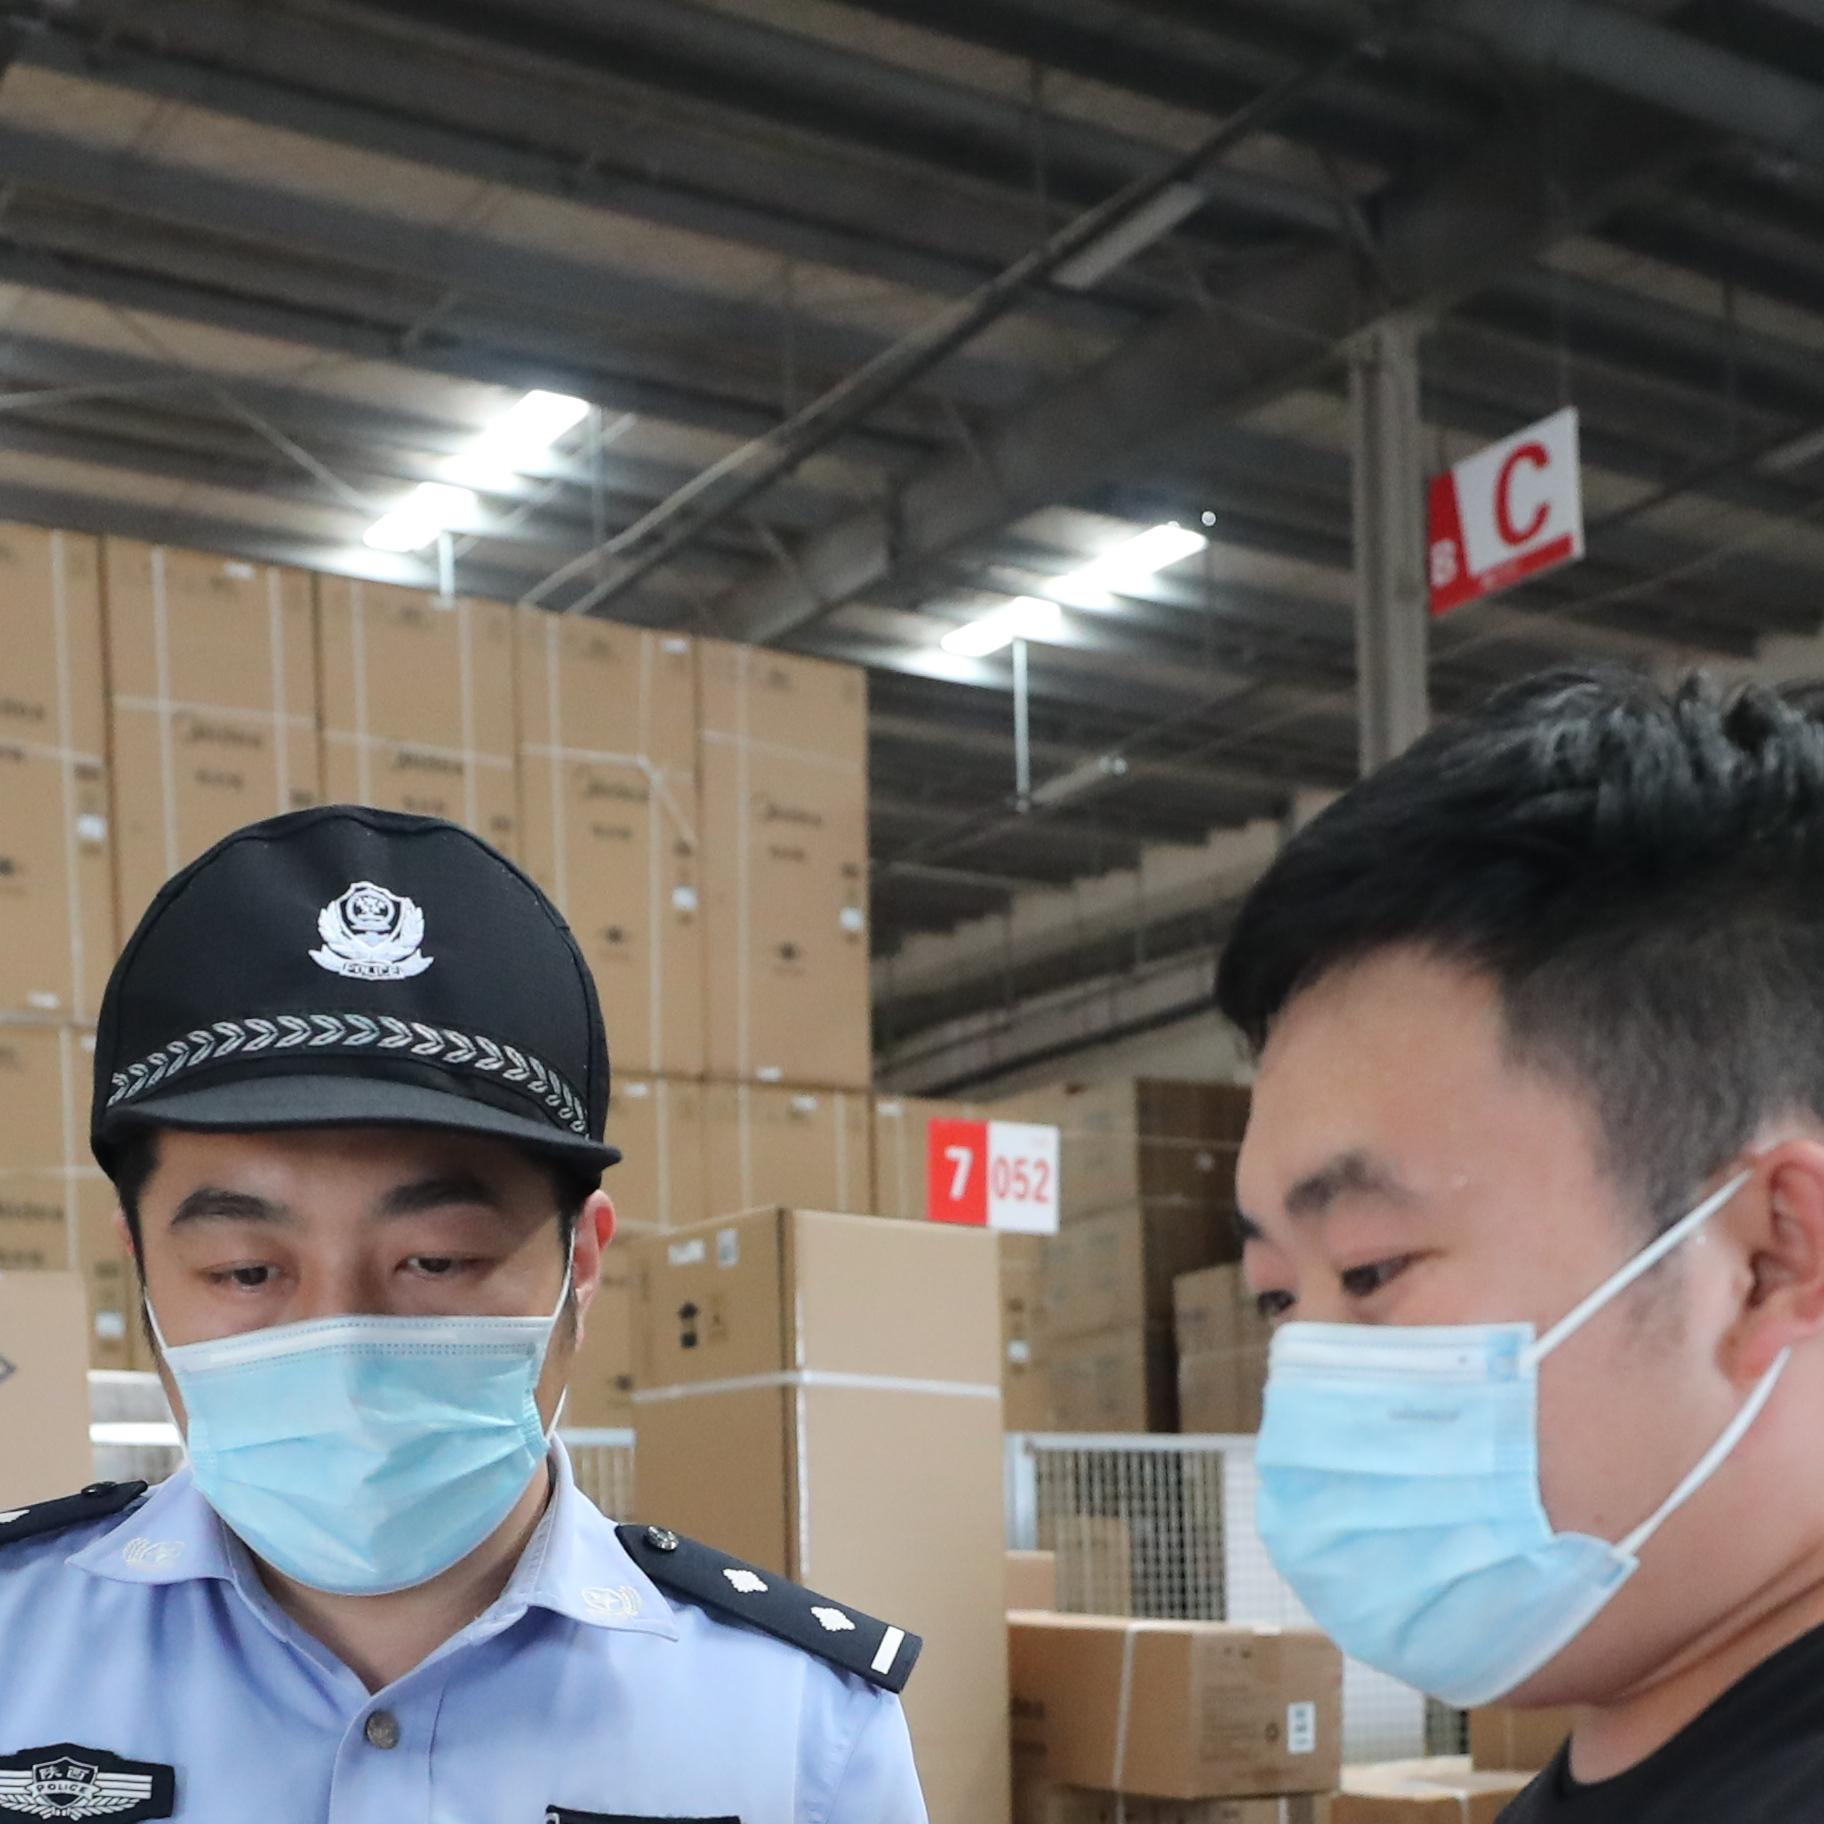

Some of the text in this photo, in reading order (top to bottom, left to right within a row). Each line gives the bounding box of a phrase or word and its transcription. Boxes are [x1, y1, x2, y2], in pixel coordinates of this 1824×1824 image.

[1494, 442, 1549, 546] C
[943, 1144, 1050, 1205] 7 052
[36, 1783, 88, 1794] POLICE
[39, 1766, 90, 1781] 陕西
